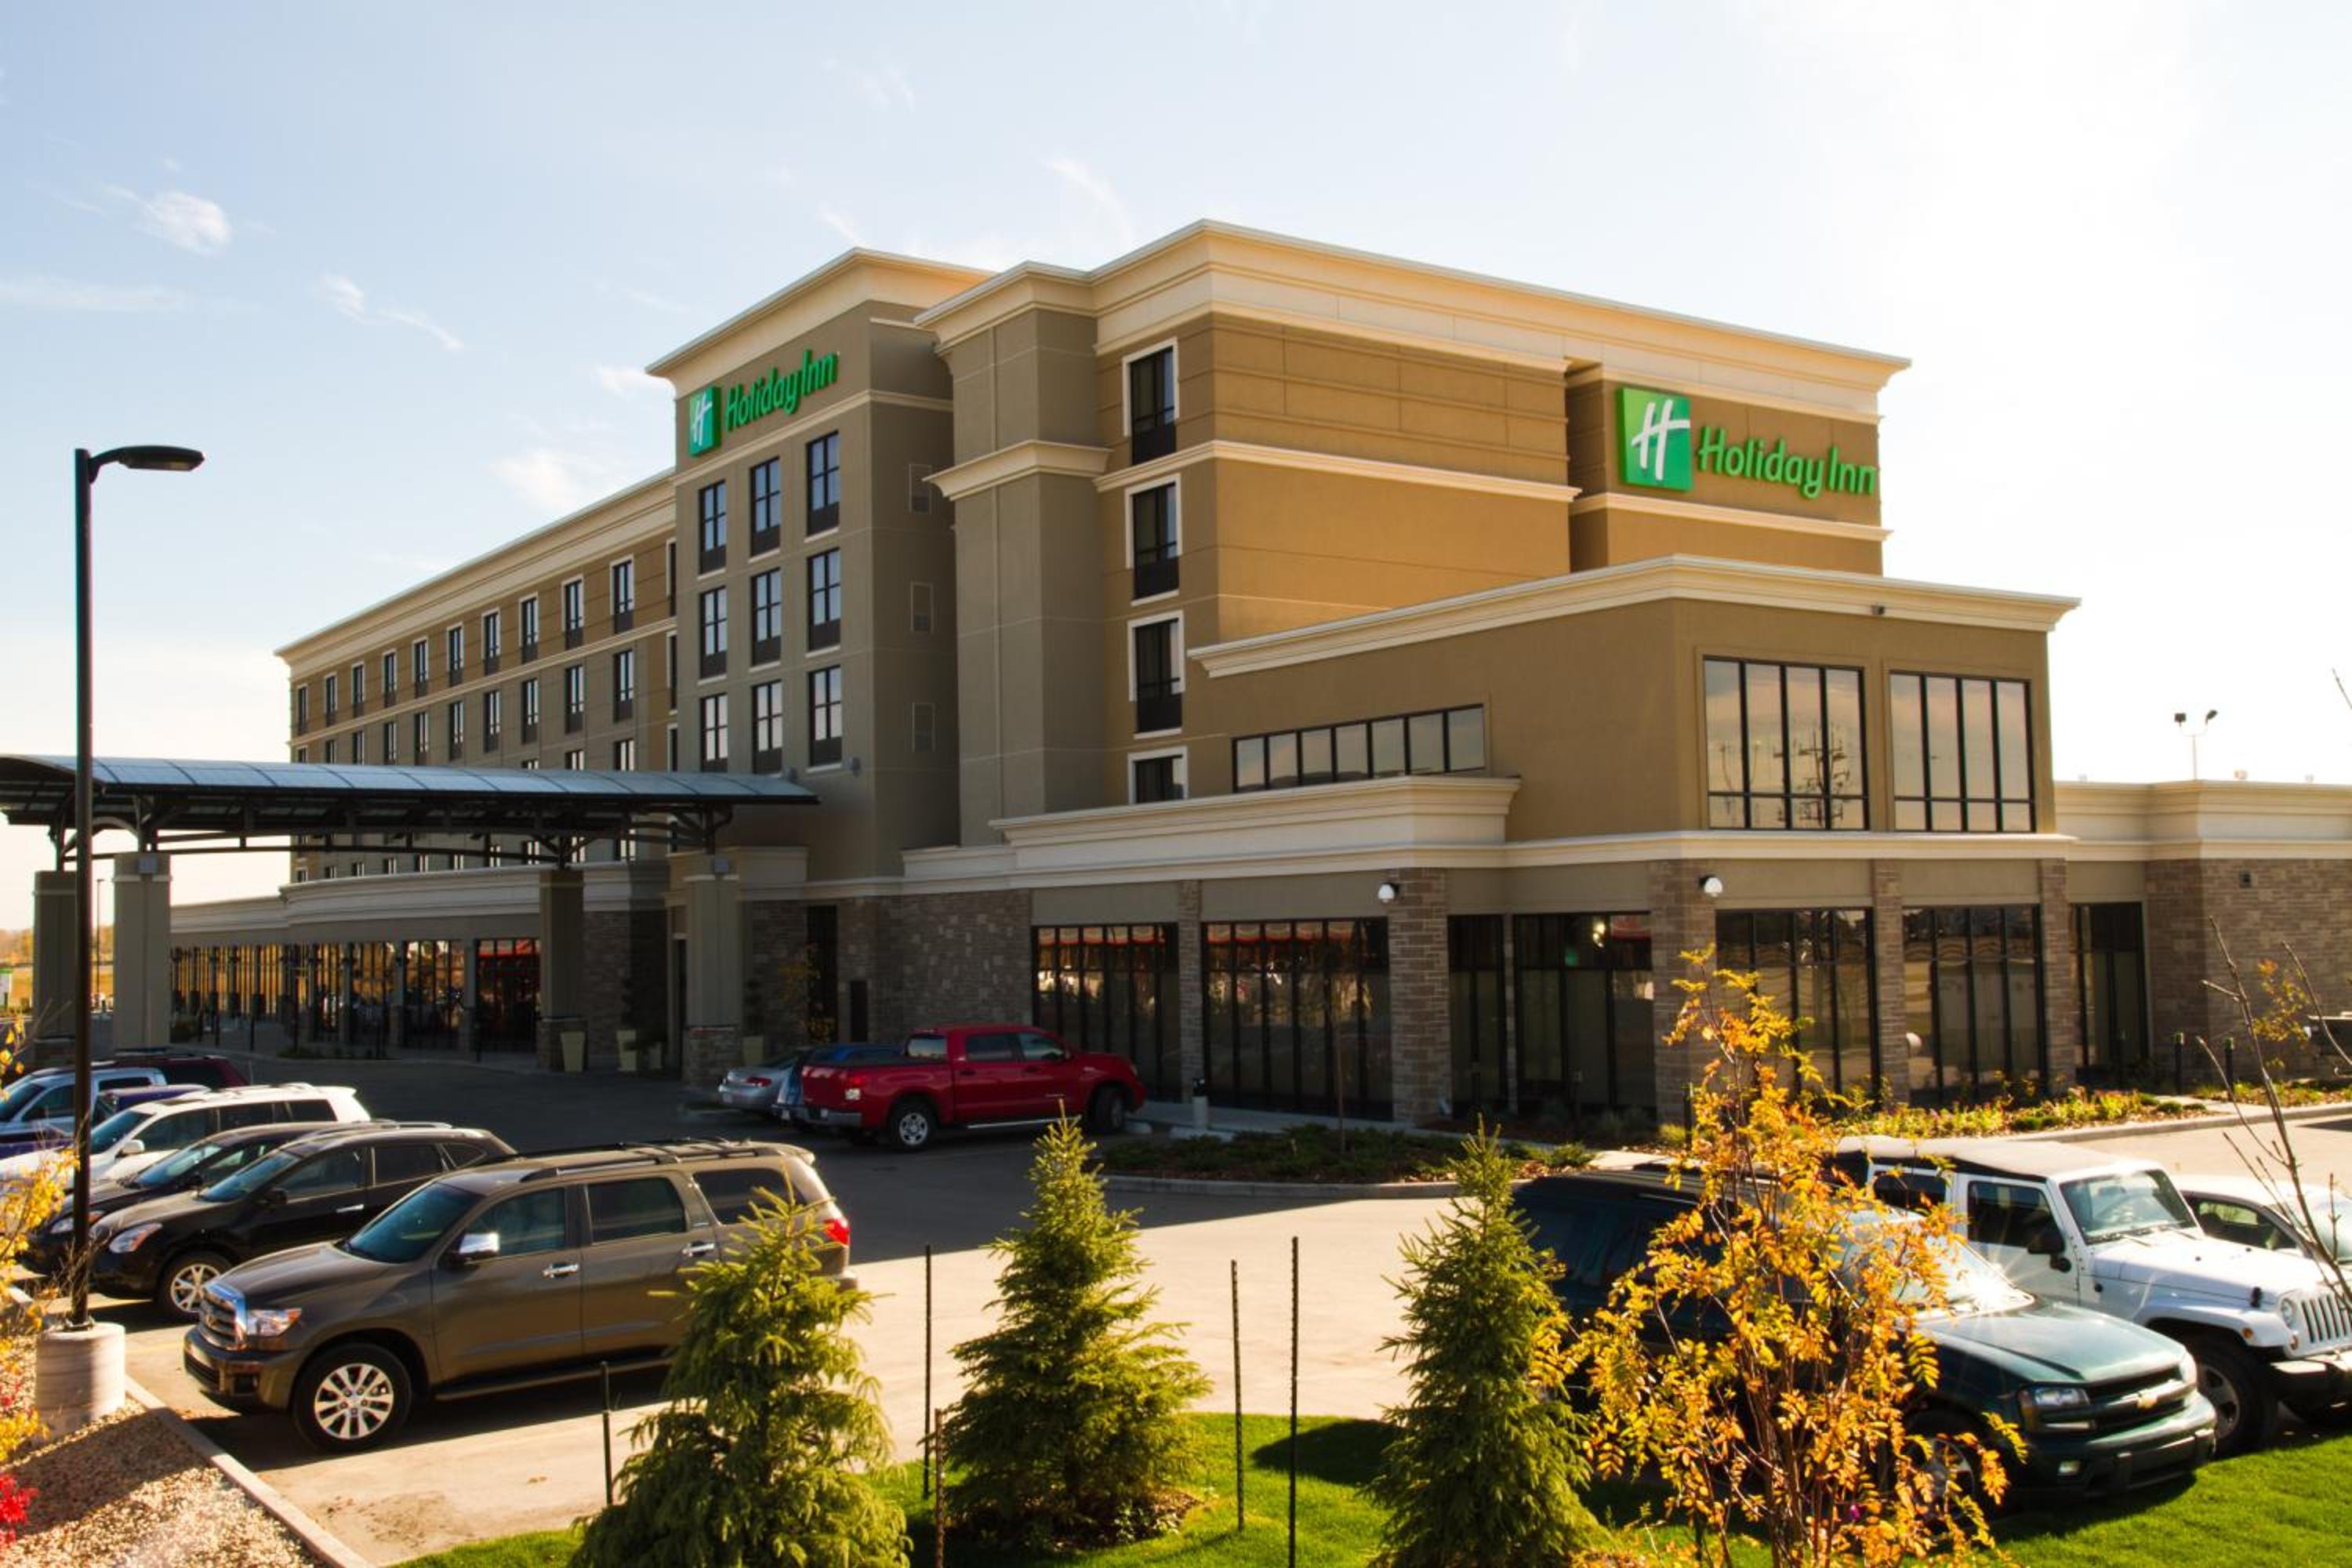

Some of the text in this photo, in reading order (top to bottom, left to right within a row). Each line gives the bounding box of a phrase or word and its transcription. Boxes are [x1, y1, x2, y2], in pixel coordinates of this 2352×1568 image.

[724, 350, 838, 431] Holiday Inn
[1697, 425, 1877, 499] Holiday Inn
